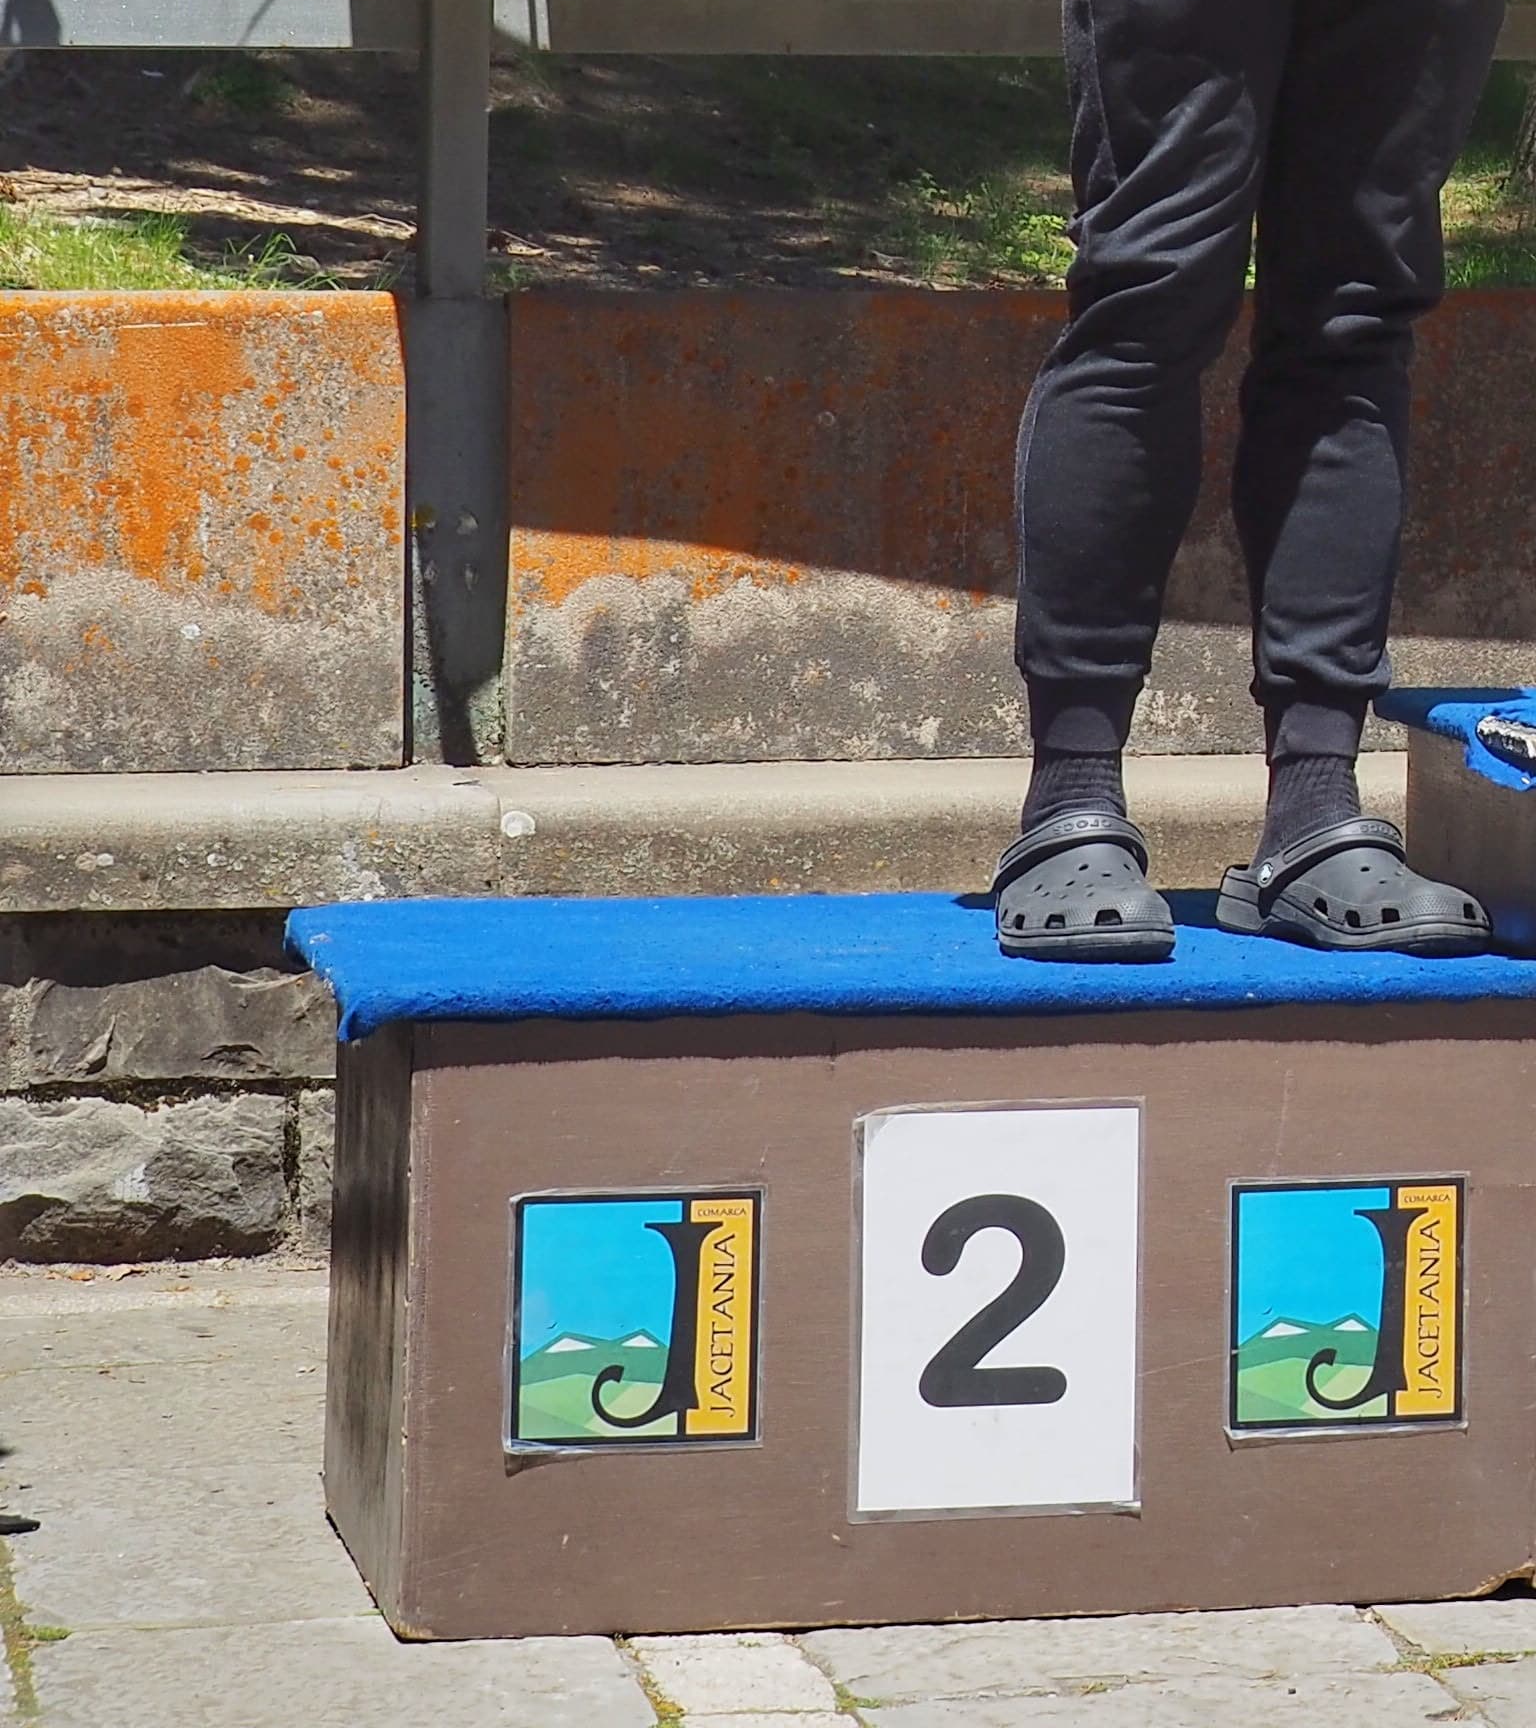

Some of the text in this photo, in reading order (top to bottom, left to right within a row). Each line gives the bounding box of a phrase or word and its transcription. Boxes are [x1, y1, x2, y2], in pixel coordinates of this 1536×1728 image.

[697, 1206, 747, 1217] COMARCA
[1404, 1192, 1451, 1203] COMARCA
[710, 1234, 736, 1418] JACETANIA
[917, 1194, 1068, 1408] 2
[1418, 1218, 1442, 1399] JACETANIA
